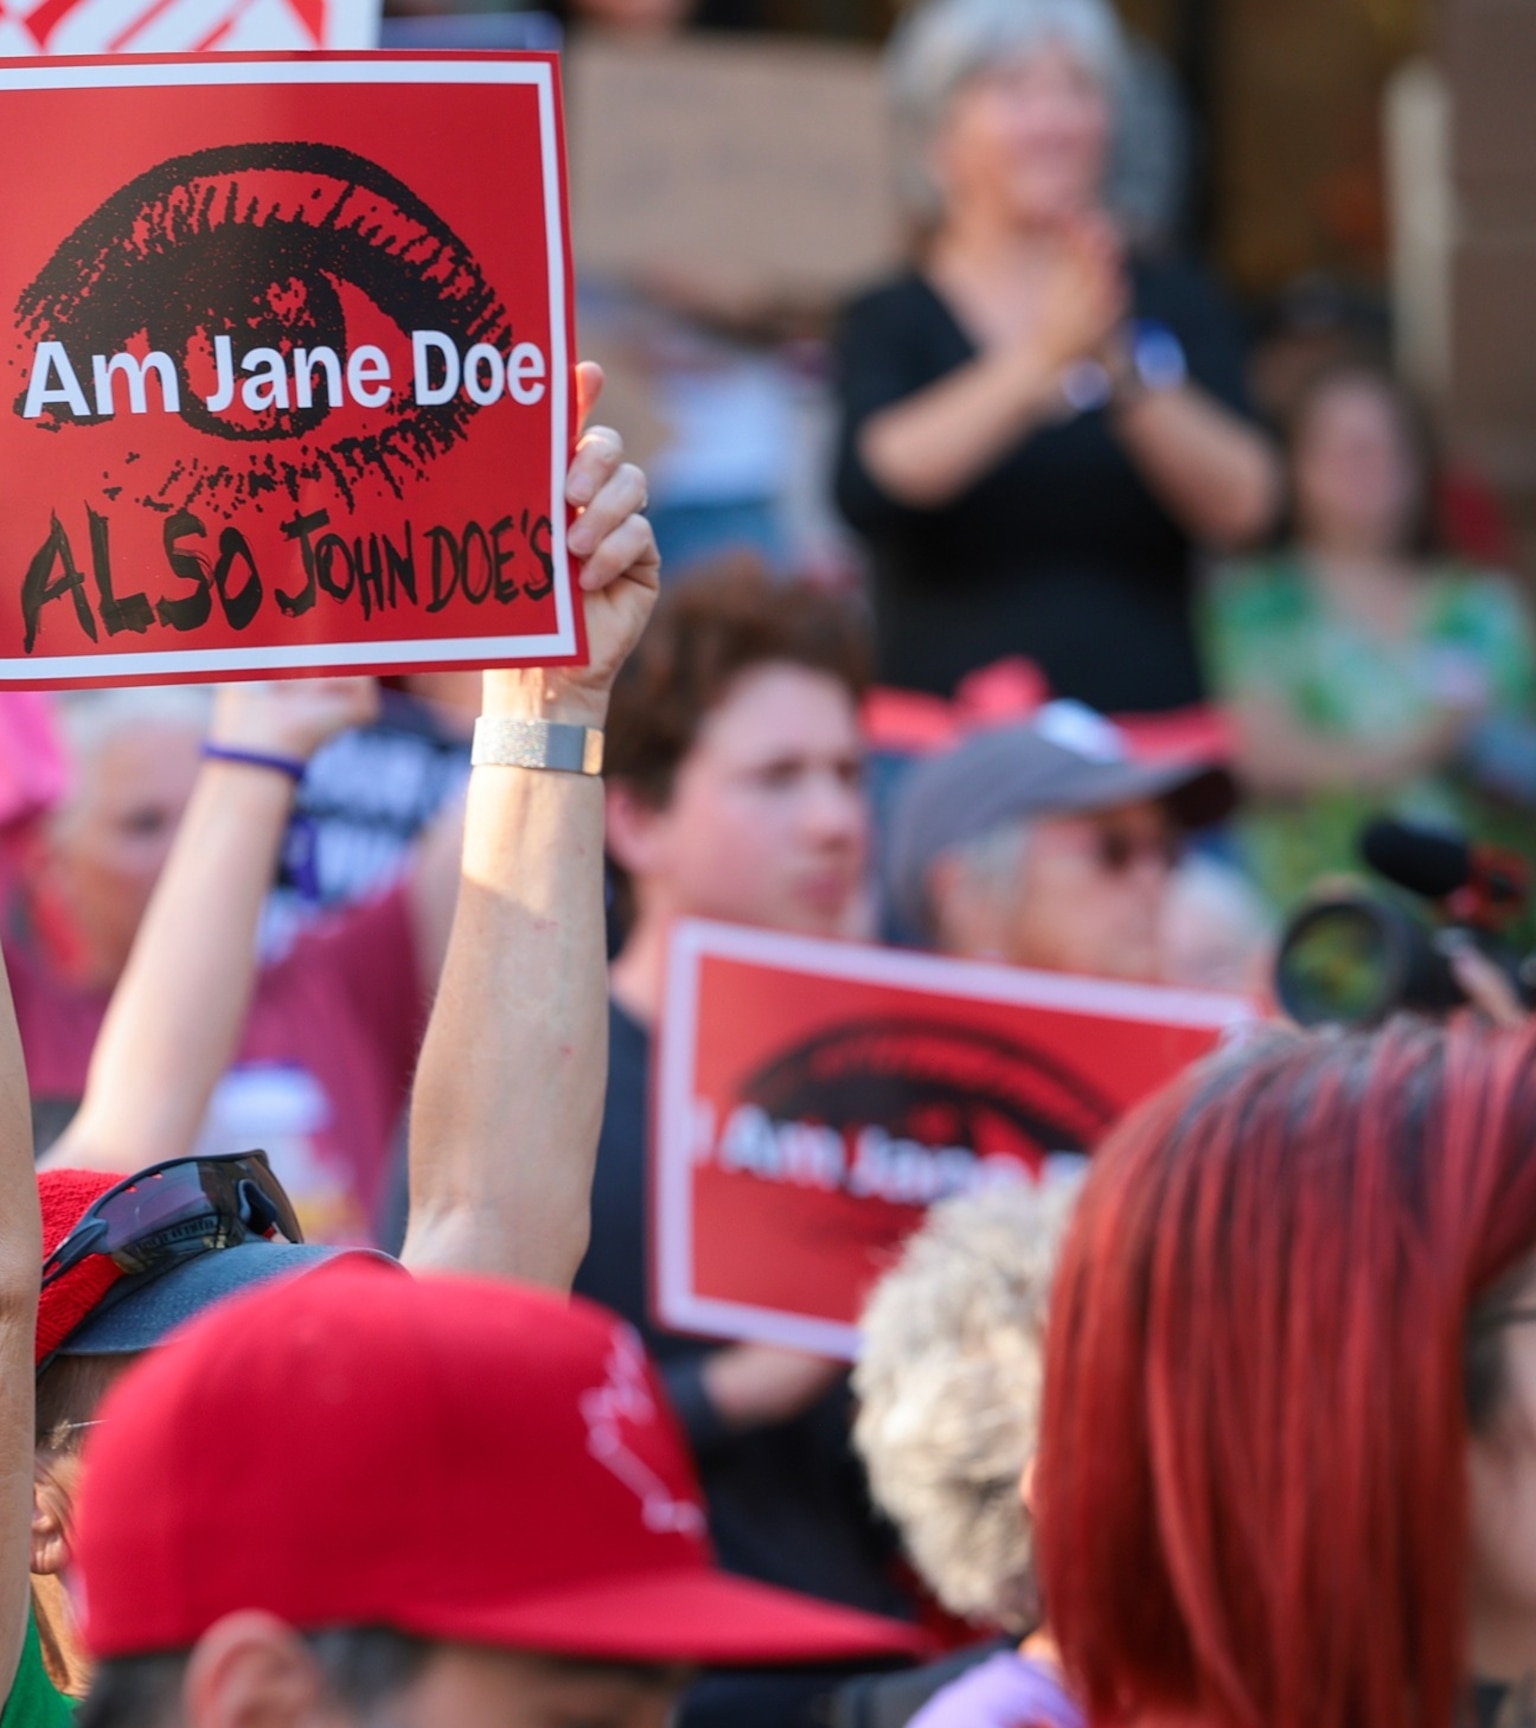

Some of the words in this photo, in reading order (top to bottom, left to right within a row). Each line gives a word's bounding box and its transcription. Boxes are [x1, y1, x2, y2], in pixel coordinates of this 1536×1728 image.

[23, 341, 180, 419] Am
[206, 335, 392, 411] Jane
[412, 330, 545, 406] Doe
[22, 502, 262, 654] ALSO
[274, 508, 417, 621] JOHN
[717, 1102, 846, 1192] Am
